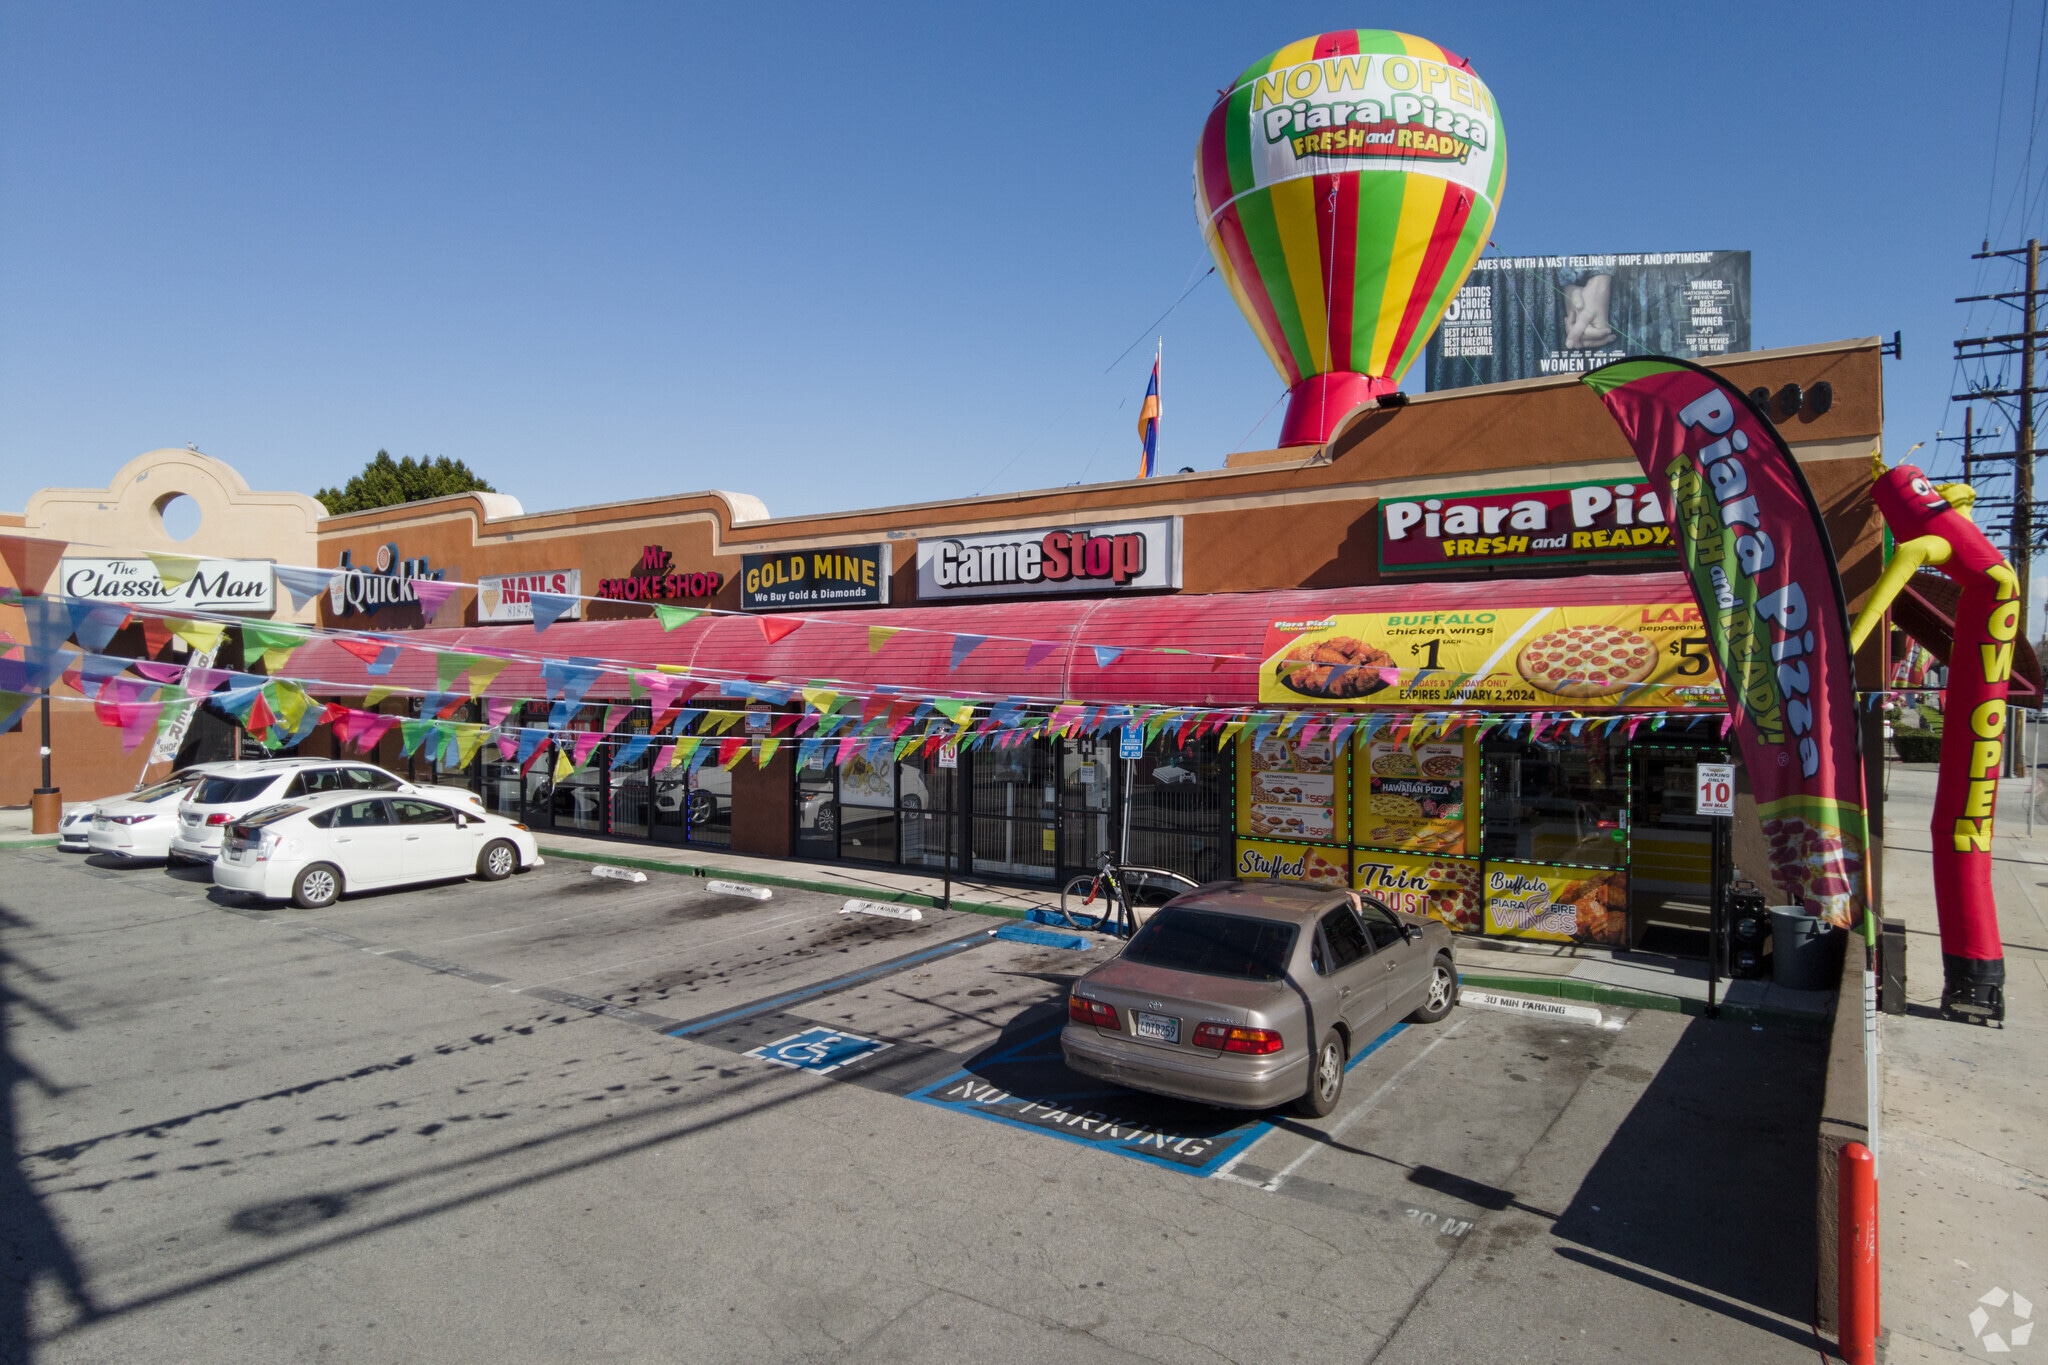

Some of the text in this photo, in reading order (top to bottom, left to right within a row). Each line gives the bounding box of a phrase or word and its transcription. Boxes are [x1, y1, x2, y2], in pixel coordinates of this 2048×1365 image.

[1252, 56, 1493, 120] NOW OPEN
[1267, 95, 1487, 147] Piara Pizza
[1293, 129, 1471, 163] FRESH and READY!
[1473, 259, 1498, 270] EAVES
[1500, 259, 1512, 269] US
[1514, 258, 1536, 269] WITH
[1538, 258, 1545, 268] A
[1545, 257, 1567, 268] VAST
[1569, 256, 1604, 267] FEELING
[1605, 255, 1617, 266] OF
[1619, 254, 1641, 266] HOPE
[1644, 254, 1662, 265] AND
[1460, 286, 1491, 298] CRITICS
[1691, 280, 1723, 290] WINNER
[1460, 297, 1491, 309] CHOICE
[1460, 309, 1492, 320] AWARD
[1691, 316, 1723, 326] WINNER
[1444, 326, 1493, 338] BEST PICTURE
[1444, 336, 1493, 347] BEST DIRECTOR
[1709, 337, 1730, 345] MOVIES
[1444, 346, 1494, 357] BEST ENSEMBLE
[1540, 359, 1584, 372] WOMEN
[1677, 388, 1775, 578] Piara
[1386, 499, 1548, 541] Piara
[1441, 526, 1675, 557] FRESH and READY
[642, 545, 673, 570] Mr.
[933, 531, 1142, 587] GameStop
[107, 561, 138, 576] The
[746, 554, 876, 594] GOLD MINE
[185, 570, 268, 598] Man
[501, 573, 567, 605] NAILS
[598, 571, 720, 600] SMOKE SHOP
[754, 587, 867, 603] We Buy Gold & Diamonds
[1665, 453, 1786, 746] FRESH and READY!
[507, 605, 532, 618] 818-78
[1387, 613, 1497, 627] BUFFALO
[1641, 608, 1702, 624] LAR
[1980, 558, 2021, 684] NOW
[1386, 626, 1494, 636] chicken wings
[1440, 679, 1446, 687] &
[1487, 679, 1509, 687] ONLY
[1755, 581, 1819, 780] Pizza
[1399, 689, 1440, 700] EXPIRES
[1443, 689, 1492, 701] JANUARY
[528, 701, 550, 714] OPE
[159, 742, 178, 753] SHOP
[940, 744, 956, 760] 10
[1953, 698, 2006, 853] OPEN
[1382, 783, 1424, 793] HAWAIIAN
[1425, 785, 1449, 795] PIZZA
[1700, 782, 1731, 803] 10
[1238, 849, 1305, 879] Stuffed
[1357, 863, 1431, 891] Thin
[1490, 871, 1548, 895] Buffalo
[1491, 898, 1577, 915] PIARA FIRE
[1491, 907, 1578, 935] WINGS
[1500, 997, 1520, 1008] MIN
[1522, 1001, 1566, 1015] PARKING
[947, 1081, 1213, 1156] NO PARKING
